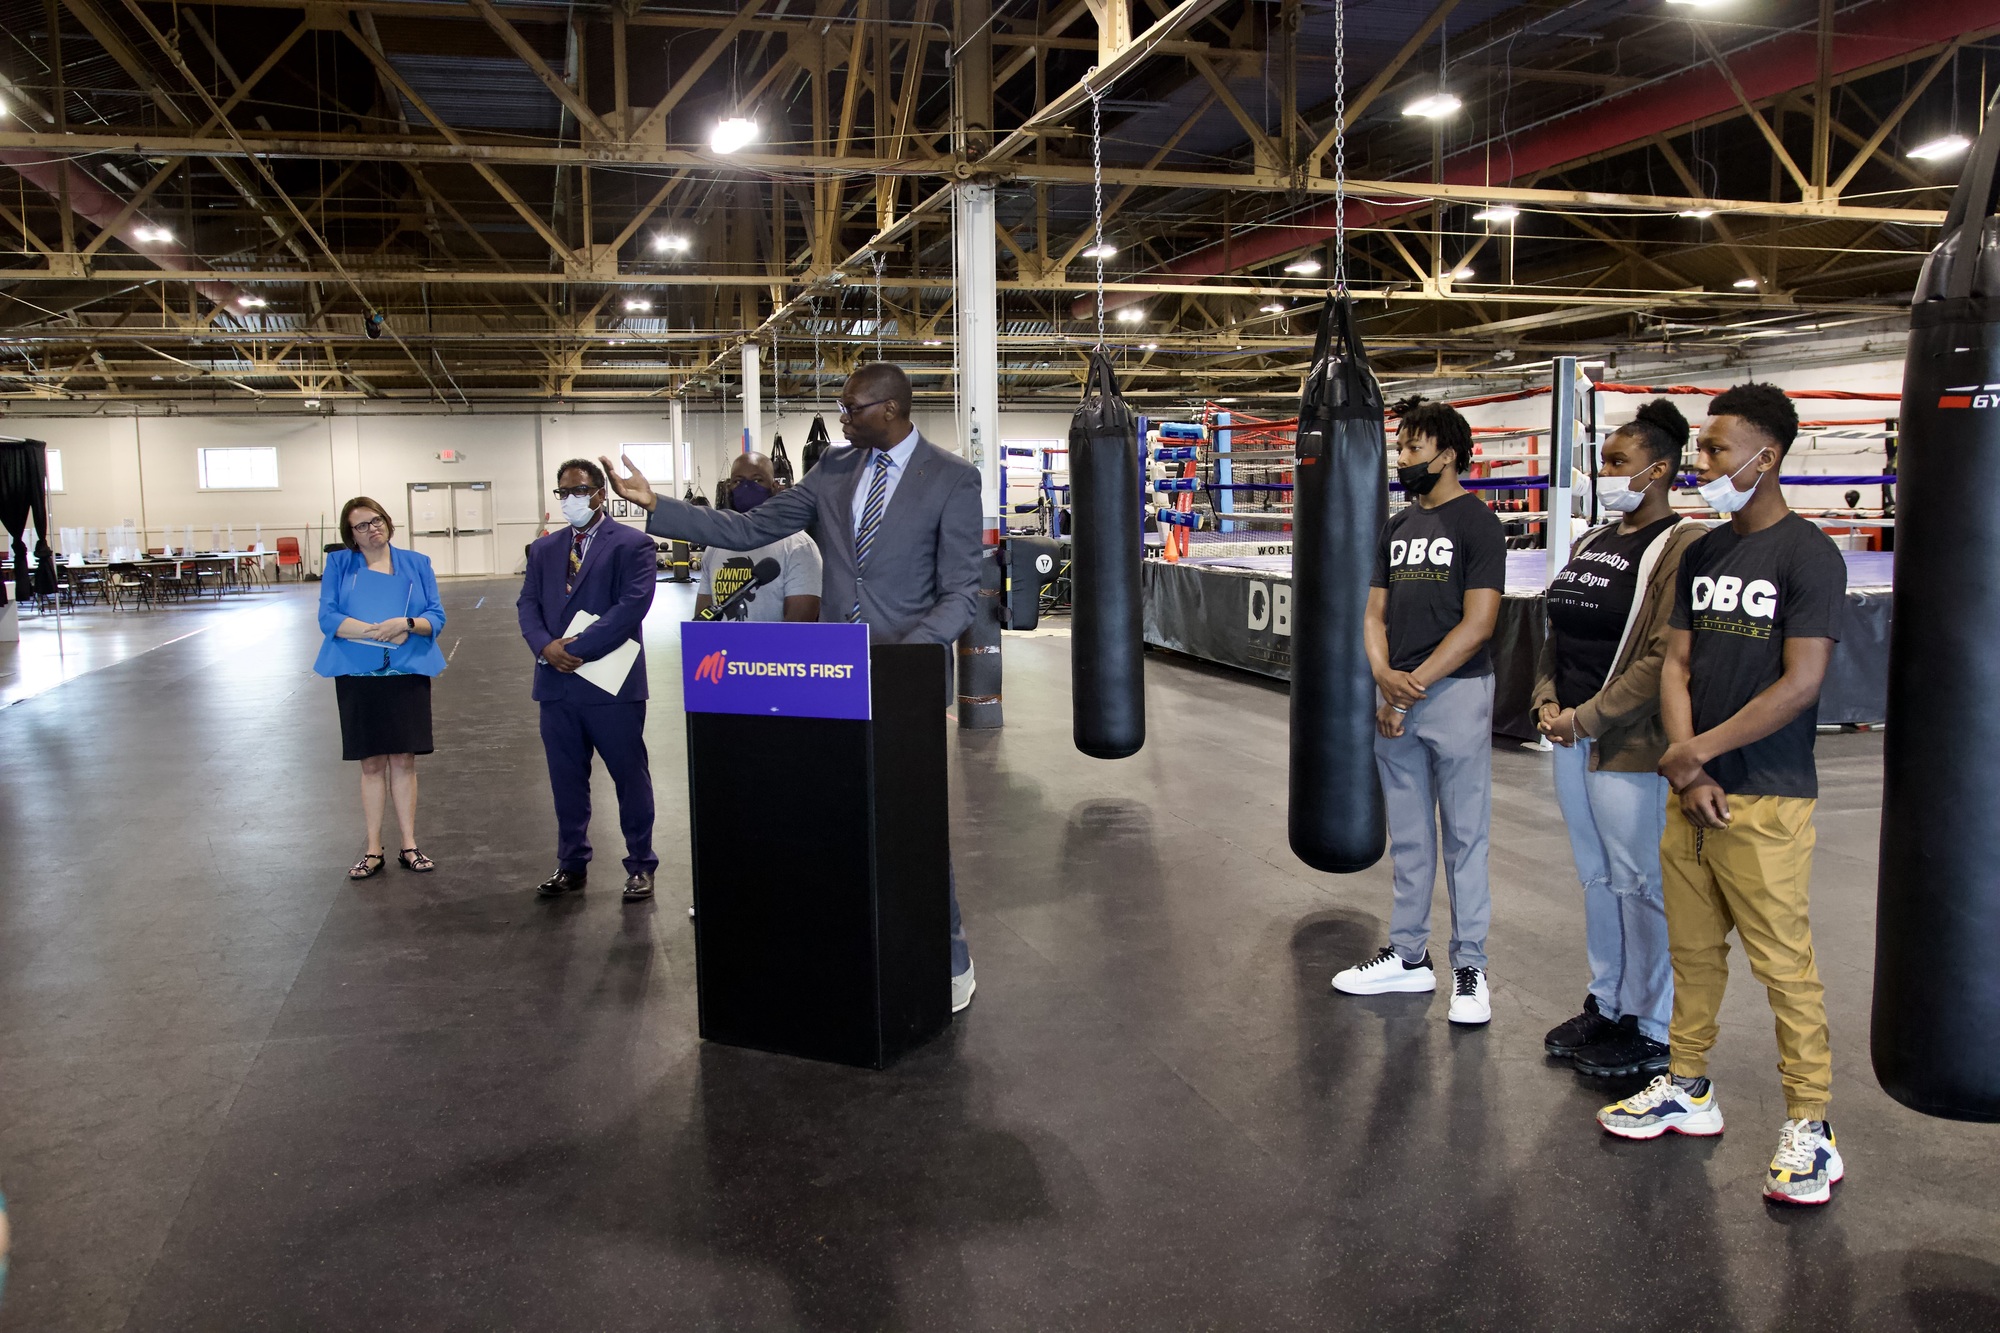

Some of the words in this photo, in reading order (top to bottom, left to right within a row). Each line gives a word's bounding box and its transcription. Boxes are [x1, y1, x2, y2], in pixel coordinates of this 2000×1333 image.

[1390, 537, 1454, 567] DBG
[1580, 601, 1599, 609] 2007
[1692, 575, 1777, 620] DBG
[728, 661, 807, 678] STUDENTS
[810, 664, 854, 679] FIRST
